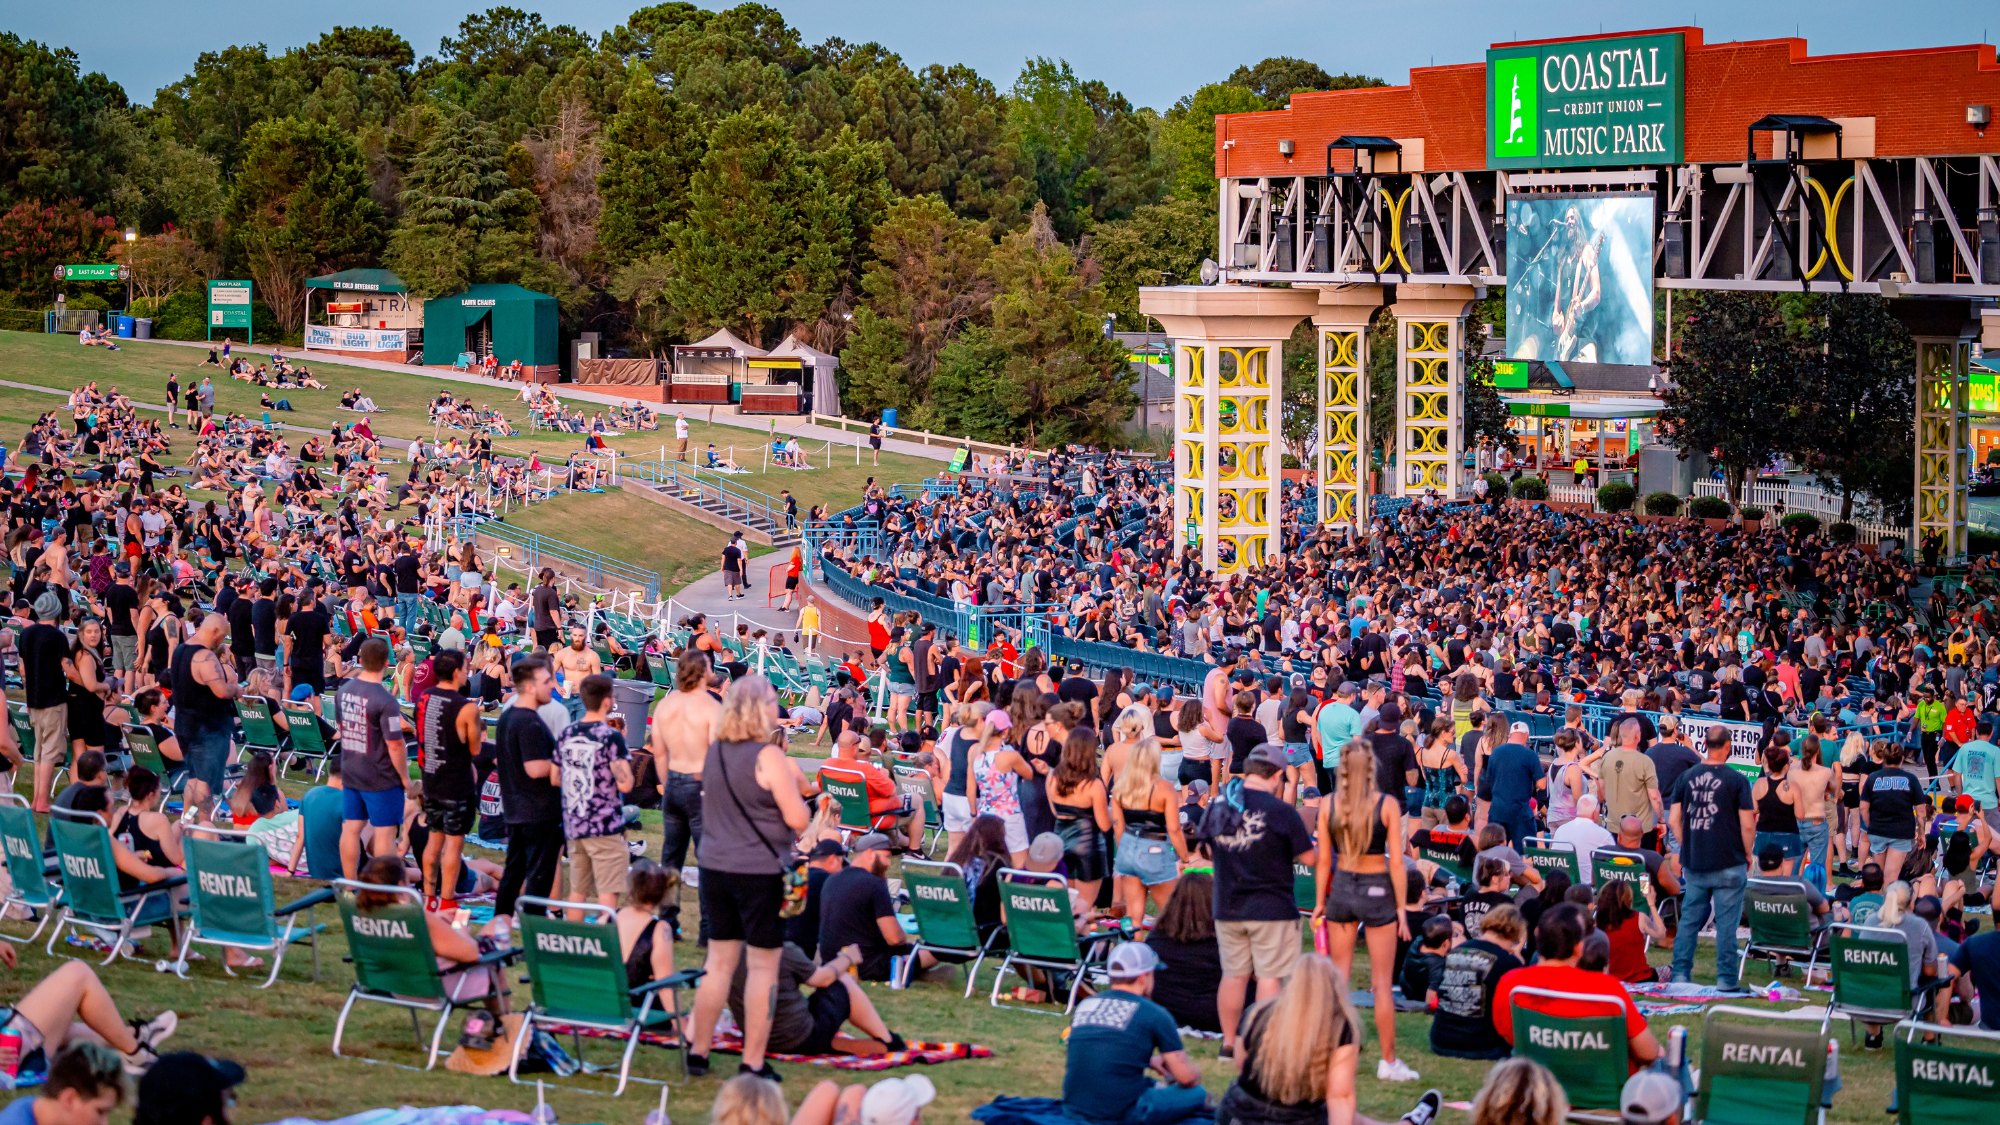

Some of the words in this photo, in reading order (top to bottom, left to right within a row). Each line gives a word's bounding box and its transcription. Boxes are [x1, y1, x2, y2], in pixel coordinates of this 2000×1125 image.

[1543, 47, 1667, 93] COASTAL
[1563, 101, 1604, 116] CREDIT
[1608, 99, 1644, 113] UNION
[1544, 126, 1608, 156] MUSIC
[1612, 123, 1666, 154] PARK
[307, 336, 335, 345] LIGHT
[312, 329, 331, 338] BUD
[346, 332, 366, 340] BUD
[381, 334, 400, 342] BUD
[342, 339, 370, 348] LIGHT
[377, 341, 403, 349] LIGHT
[1495, 363, 1514, 375] SIDE
[1530, 404, 1546, 415] BAR
[241, 709, 265, 719] RENTAL
[288, 716, 312, 726] RENTAL
[1741, 729, 1761, 745] FOR
[1689, 771, 1722, 790] INTO
[1873, 776, 1911, 792] ADTR
[827, 784, 860, 797] RENTAL
[901, 783, 927, 795] RENTAL
[1691, 790, 1715, 803] THE
[1532, 855, 1570, 868] RENTAL
[1599, 868, 1638, 882] RENTAL
[198, 870, 258, 898] RENTAL
[915, 884, 960, 902] RENTAL
[1010, 894, 1061, 913] RENTAL
[1464, 901, 1491, 913] DEATH
[1754, 900, 1798, 914] RENTAL
[351, 915, 415, 939] RENTAL
[535, 932, 609, 958] RENTAL
[1843, 948, 1899, 966] RENTAL
[1529, 1025, 1610, 1050] RENTAL
[1721, 1043, 1807, 1068] RENTAL
[1912, 1058, 1995, 1088] RENTAL
